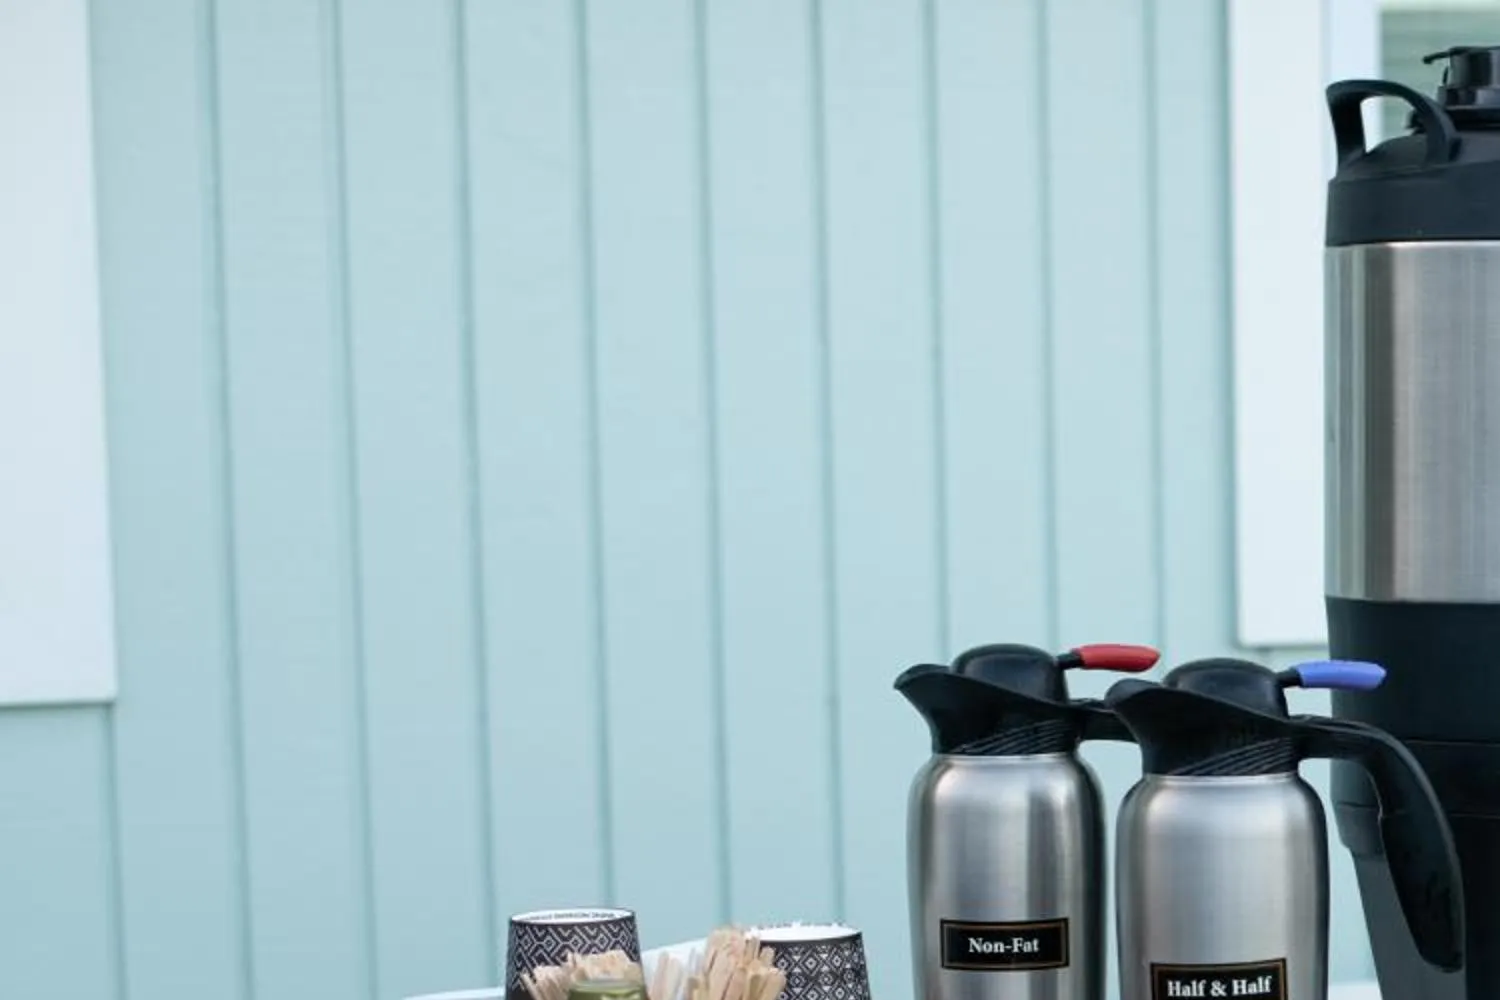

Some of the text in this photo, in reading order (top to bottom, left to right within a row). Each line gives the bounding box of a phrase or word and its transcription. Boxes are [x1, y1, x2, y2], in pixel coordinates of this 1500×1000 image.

[968, 938, 1040, 954] Non-Fat
[1168, 976, 1273, 998] Half & Half
